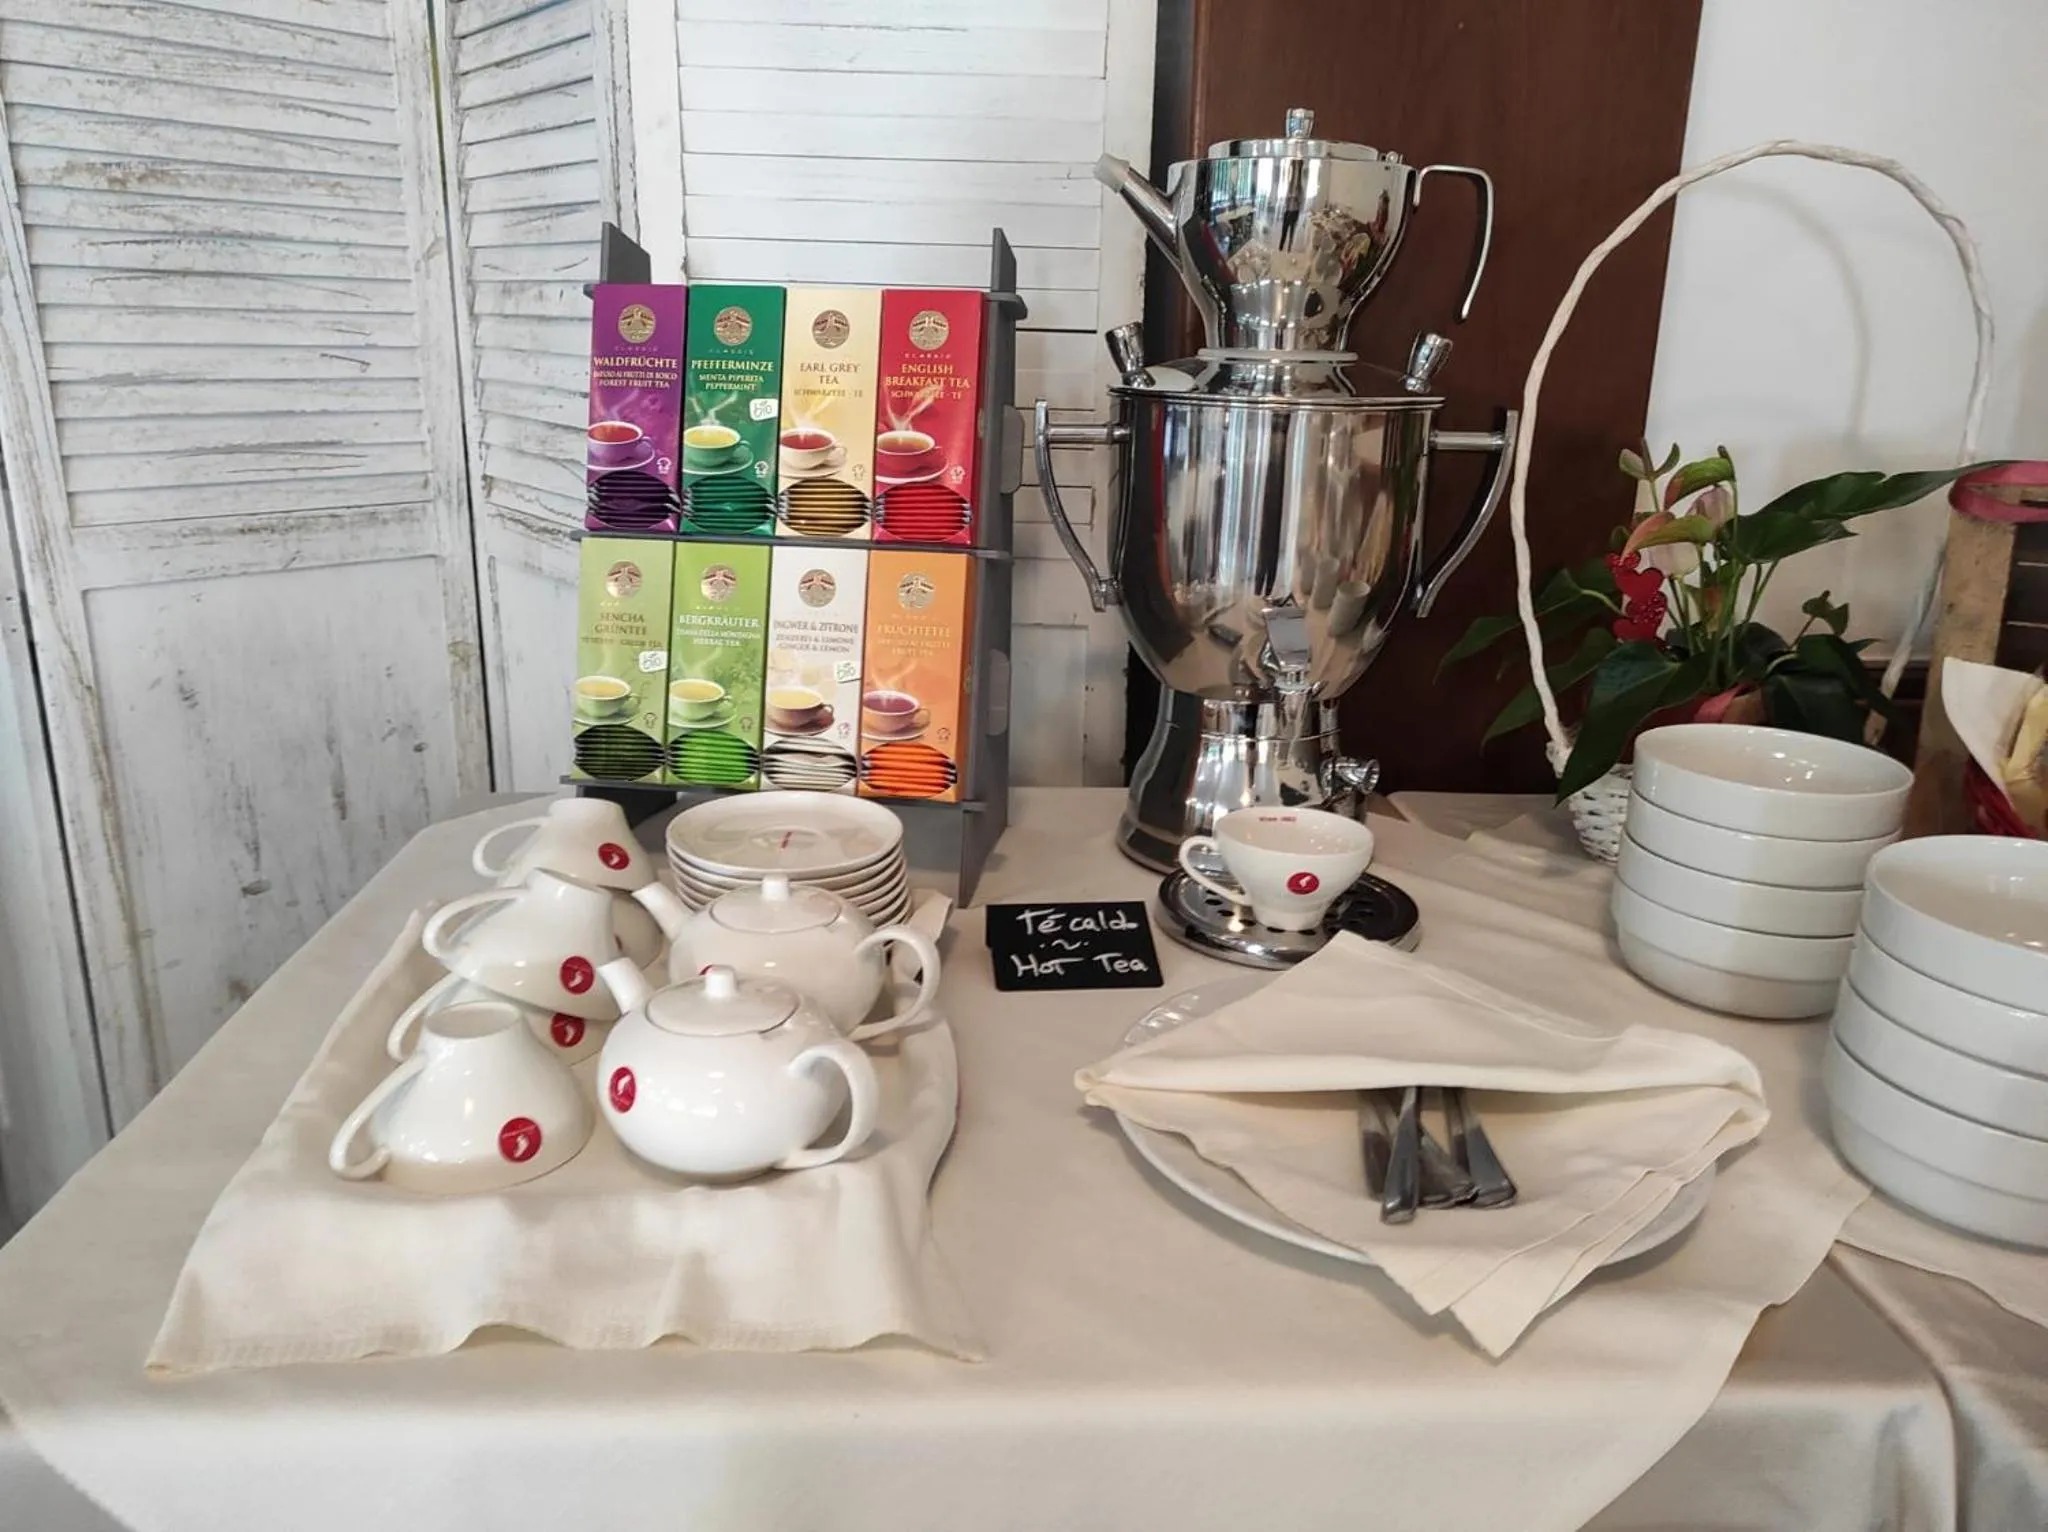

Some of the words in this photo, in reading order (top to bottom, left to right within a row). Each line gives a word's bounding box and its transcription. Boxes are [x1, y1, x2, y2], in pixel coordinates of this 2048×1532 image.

[593, 355, 678, 369] WALDFRÜCHTE
[691, 360, 775, 372] PFEFFERMINZE
[799, 362, 826, 373] EARL
[828, 362, 861, 373] GREY
[901, 363, 953, 375] ENGLISH
[654, 380, 671, 389] TEA
[819, 375, 840, 385] TEA
[885, 376, 946, 388] BREAKFAST
[949, 377, 971, 389] TEA
[1092, 952, 1149, 973] Tea
